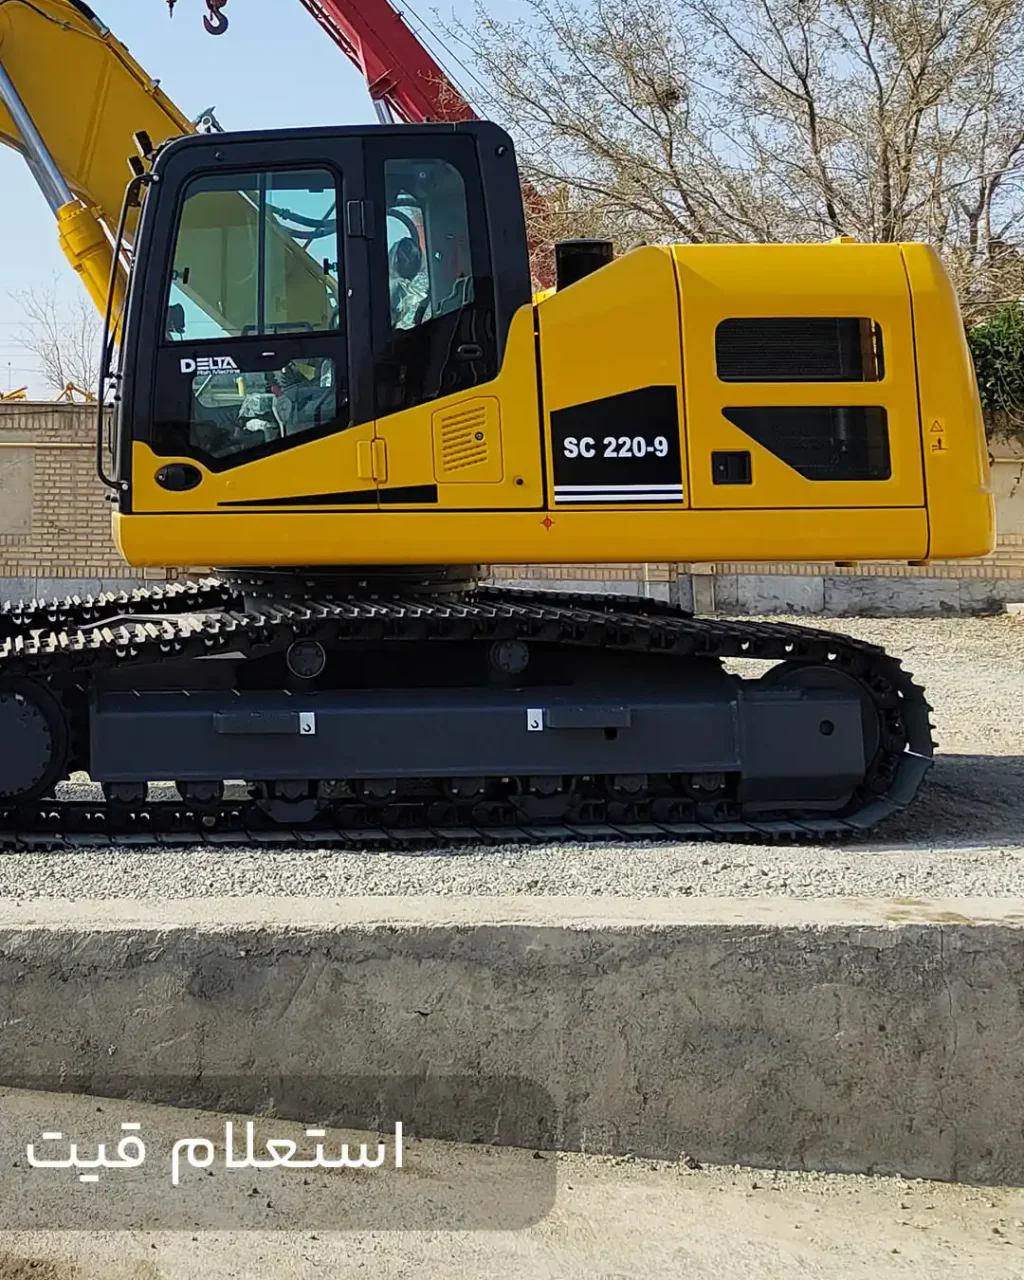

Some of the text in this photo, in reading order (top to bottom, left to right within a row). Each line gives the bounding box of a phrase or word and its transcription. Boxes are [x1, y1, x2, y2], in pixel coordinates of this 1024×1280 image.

[180, 356, 238, 373] DELTA
[563, 436, 669, 458] SC 220-9
